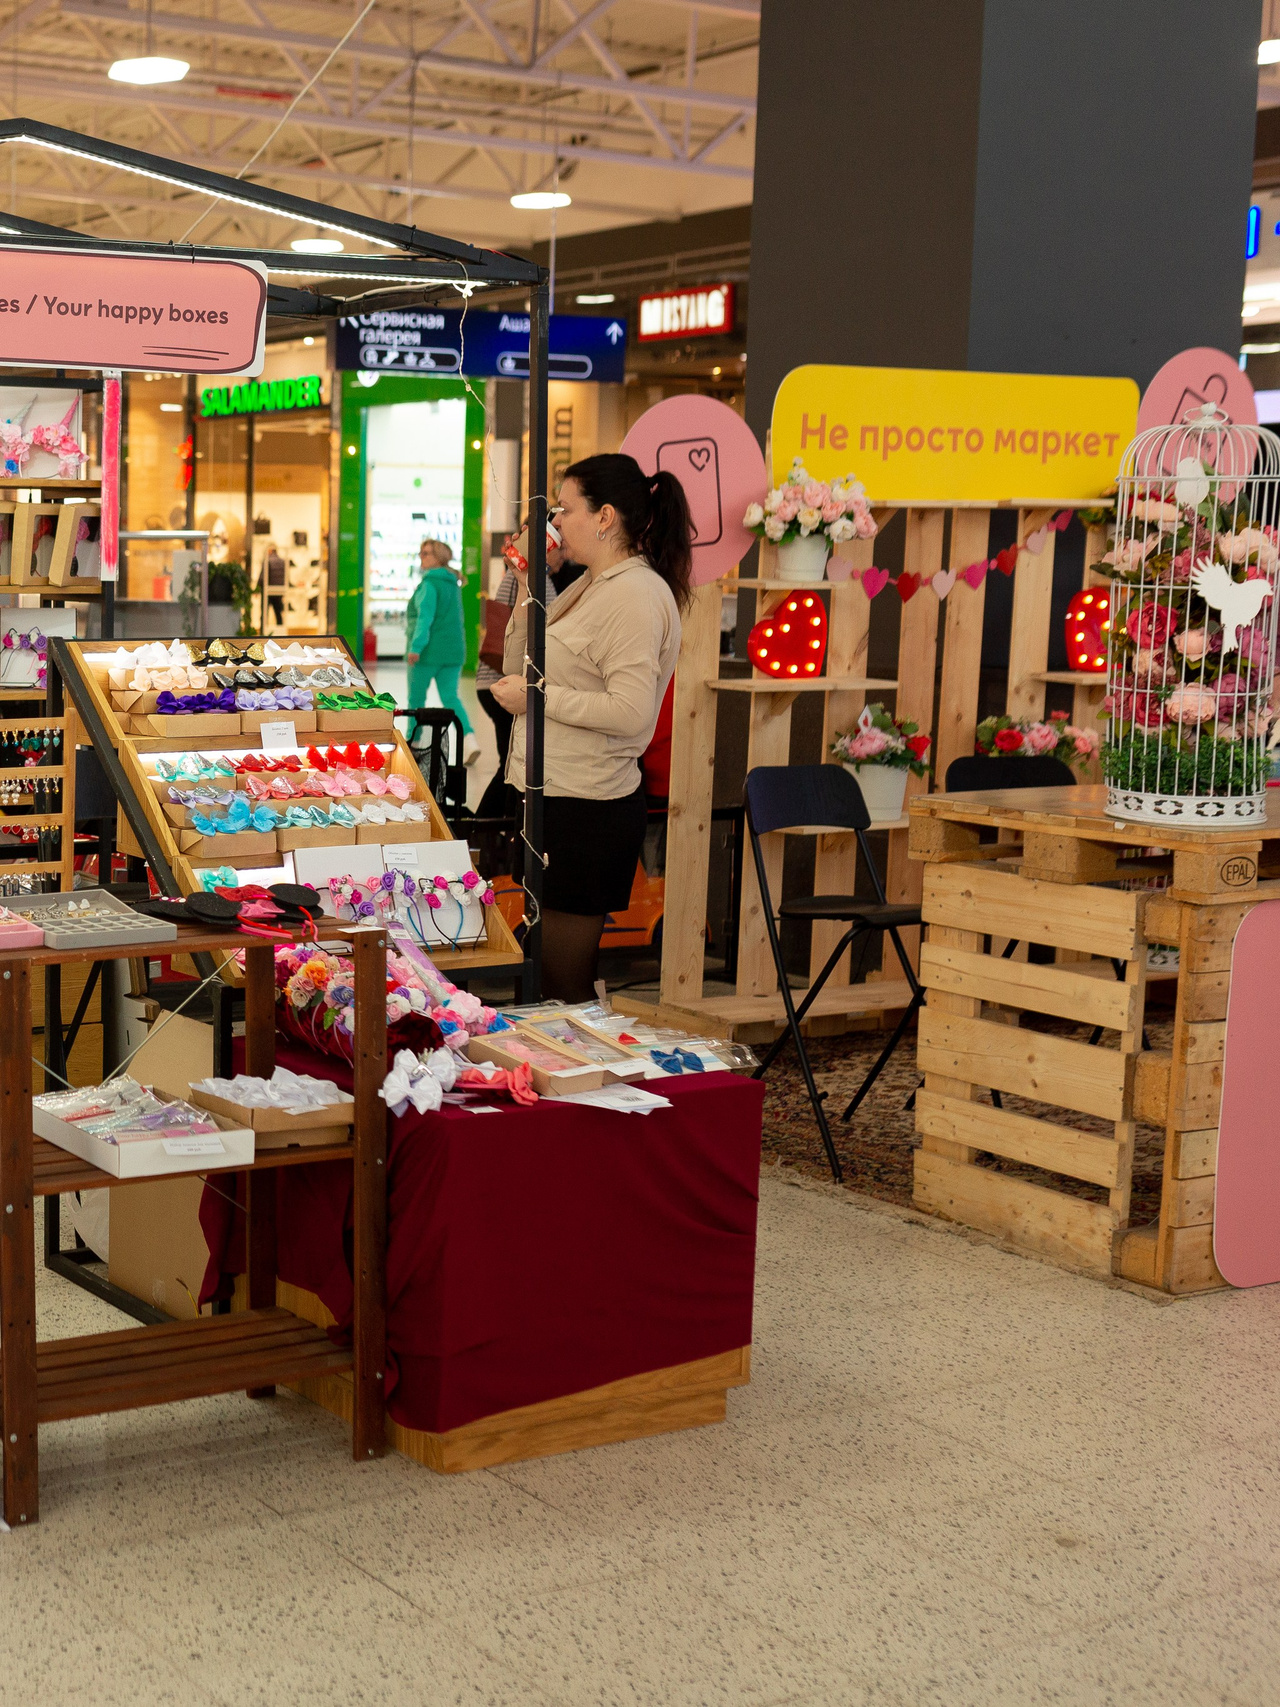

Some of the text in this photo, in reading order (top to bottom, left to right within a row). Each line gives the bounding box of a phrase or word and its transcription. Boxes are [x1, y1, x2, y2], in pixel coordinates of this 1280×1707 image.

[26, 294, 38, 315] /
[43, 295, 93, 317] Your
[97, 299, 164, 326] happy
[169, 303, 229, 325] boxes
[359, 311, 445, 330] Сервисная
[499, 313, 530, 333] Аша
[640, 289, 726, 335] MUSTANG
[359, 328, 421, 349] галерея
[201, 375, 321, 417] SALAMANDER
[800, 412, 1121, 465] Не просто маркет
[1226, 863, 1251, 881] EPAL
